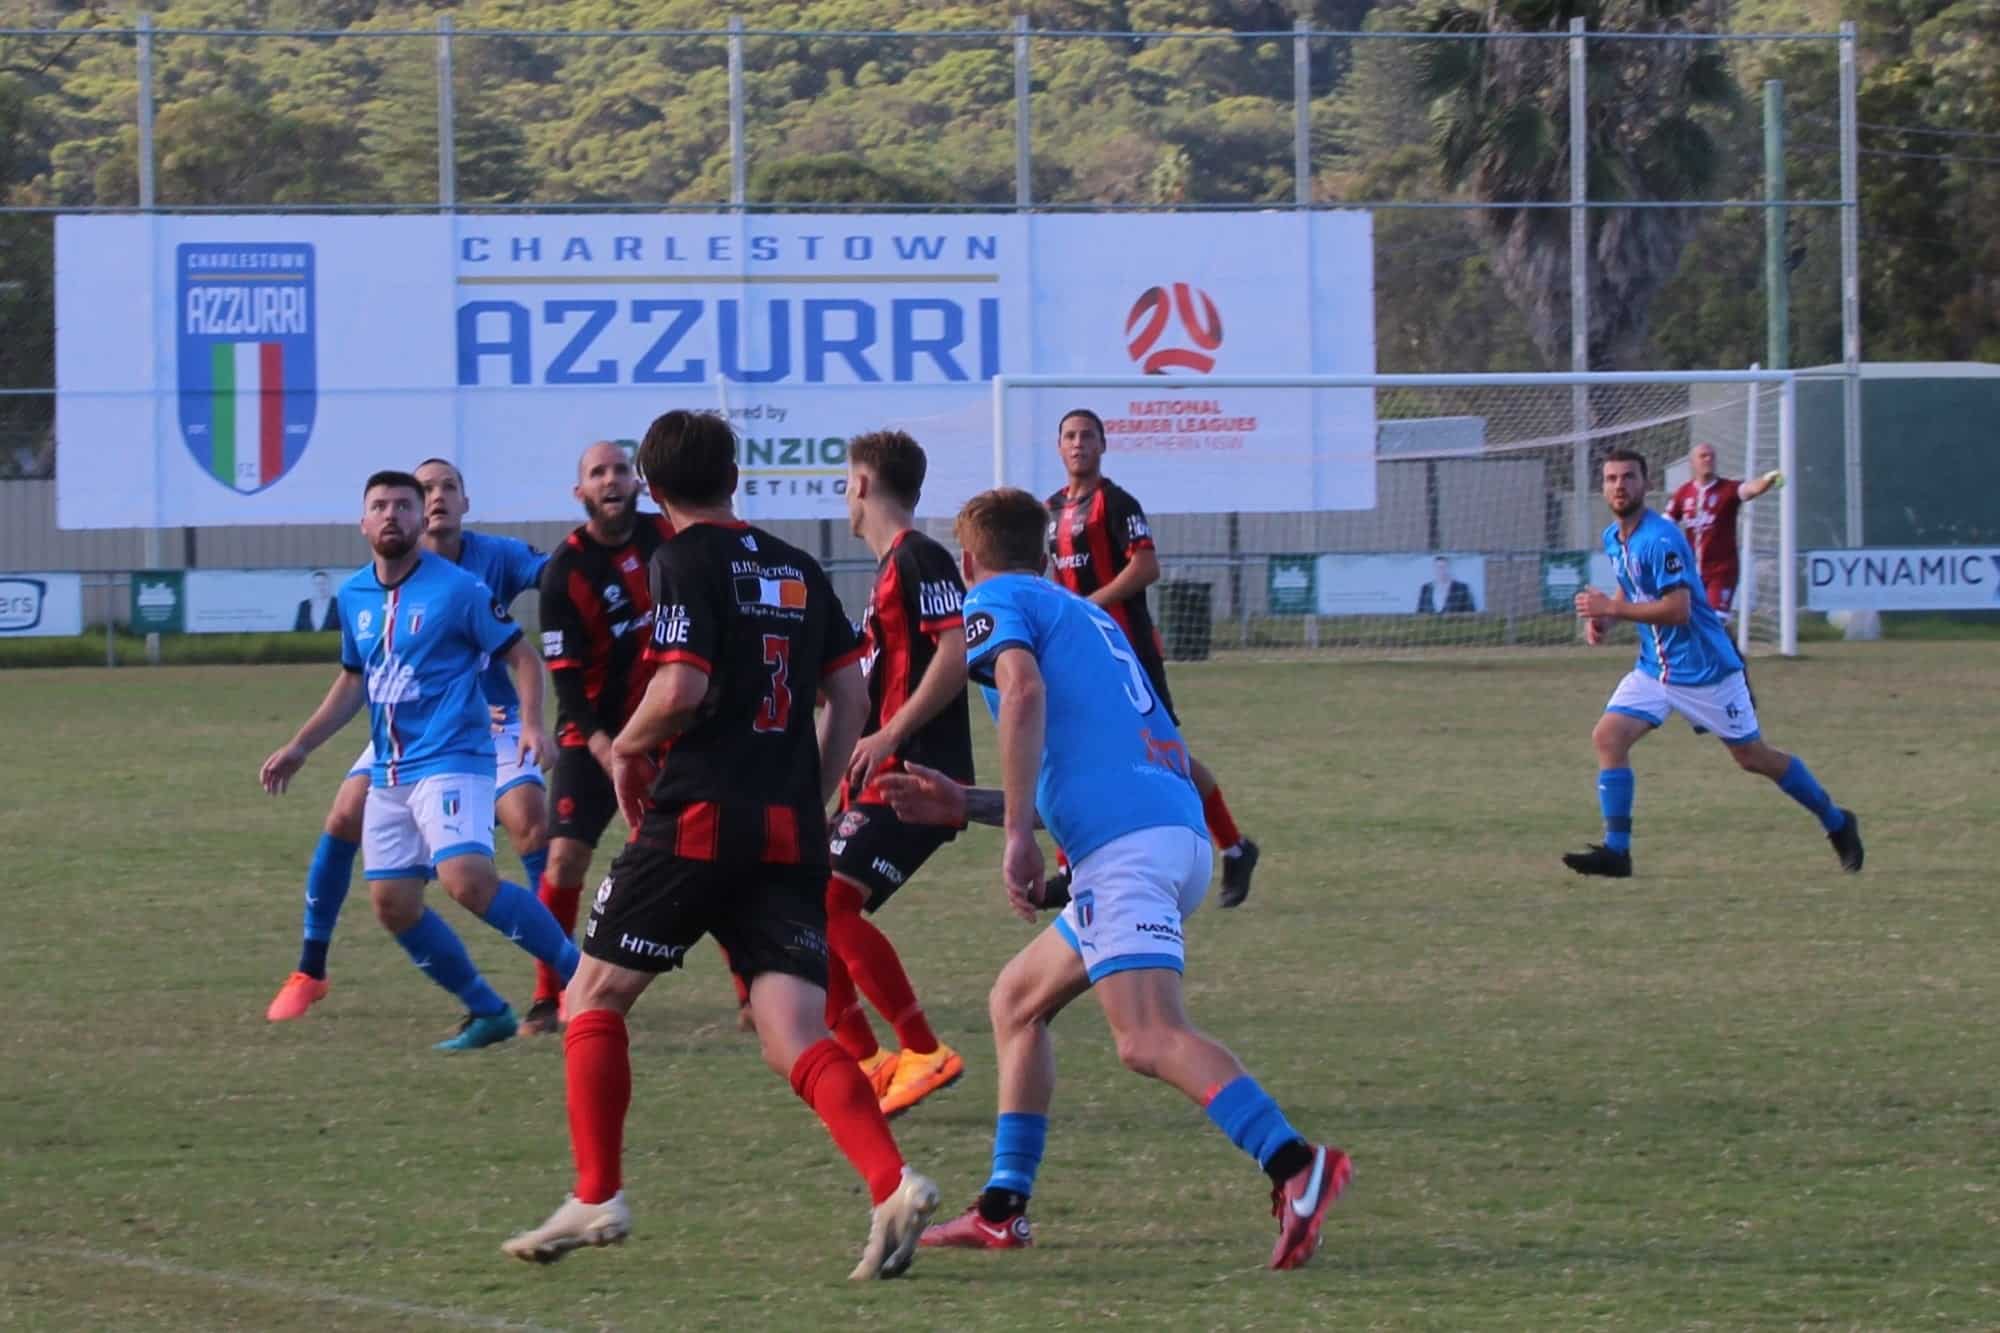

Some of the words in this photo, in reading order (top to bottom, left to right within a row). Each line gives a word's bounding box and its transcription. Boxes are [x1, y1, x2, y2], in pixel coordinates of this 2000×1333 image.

[188, 253, 305, 268] CHARLESTOWN
[462, 236, 997, 262] CHARLESTOWN
[187, 286, 306, 334] AZZURRI
[457, 298, 1000, 386] AZZURRI
[1128, 400, 1222, 417] NATIONAL
[1104, 418, 1172, 434] REMIER
[1177, 416, 1257, 432] LEAGUES
[1812, 555, 1984, 587] DYNAMIC
[753, 633, 792, 732] 3
